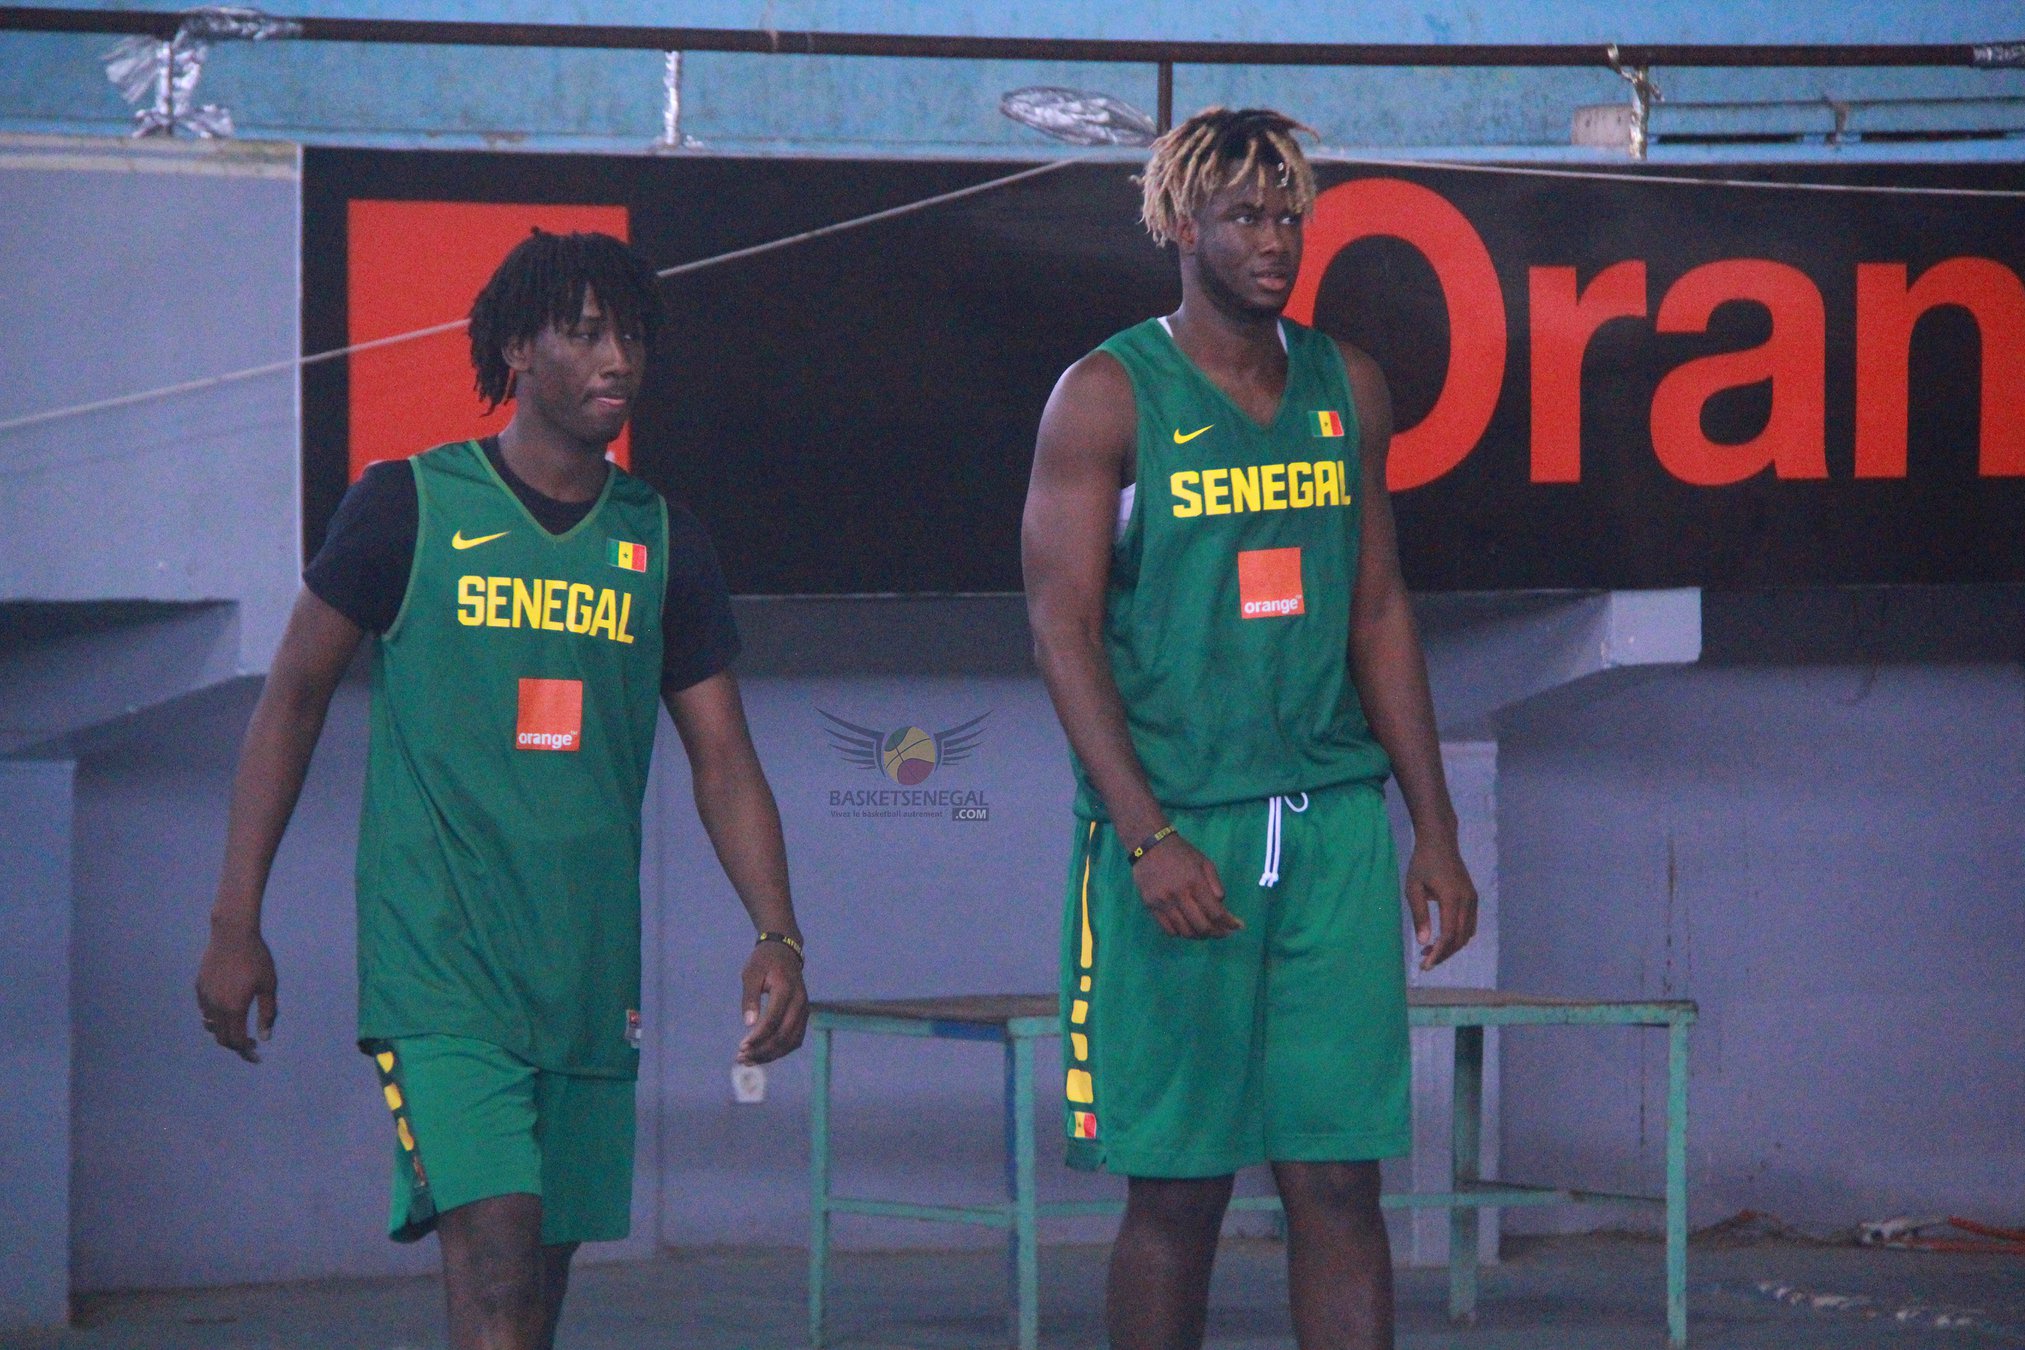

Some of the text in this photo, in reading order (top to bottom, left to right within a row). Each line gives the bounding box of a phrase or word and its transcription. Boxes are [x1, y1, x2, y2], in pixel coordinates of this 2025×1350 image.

[1170, 460, 1352, 518] SENEGAL
[457, 575, 635, 644] SENEGAL
[1244, 598, 1299, 615] orange
[518, 732, 573, 749] orange
